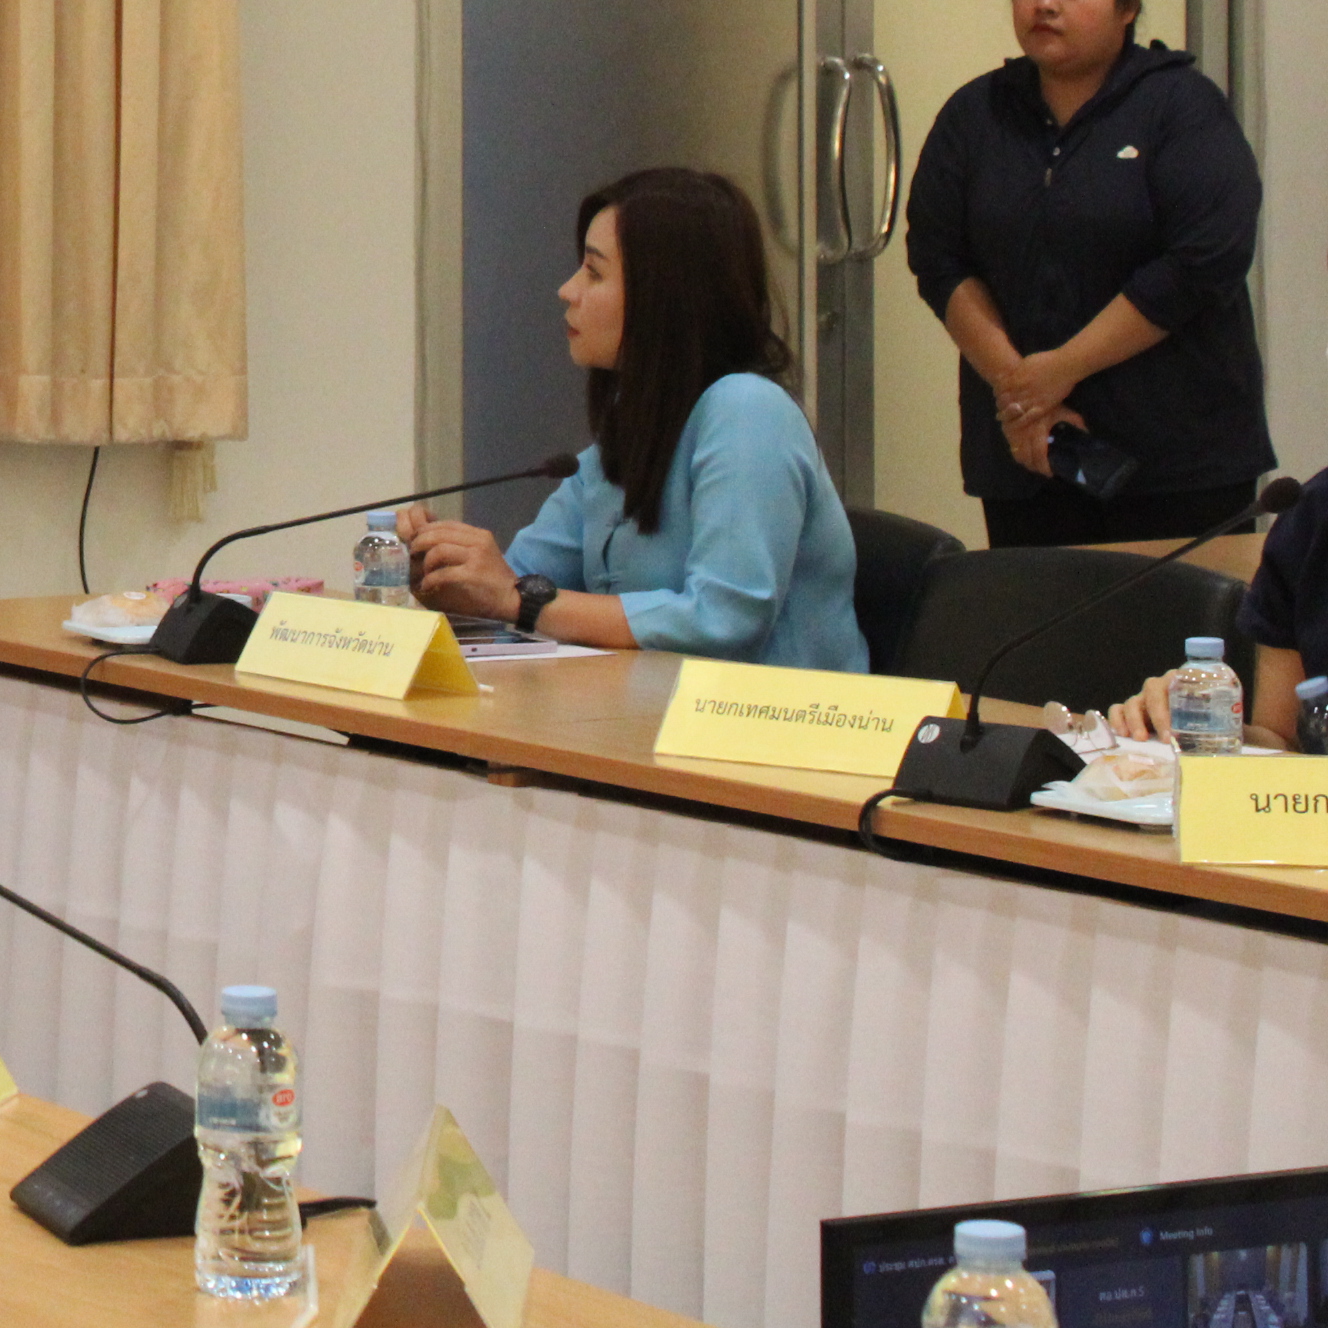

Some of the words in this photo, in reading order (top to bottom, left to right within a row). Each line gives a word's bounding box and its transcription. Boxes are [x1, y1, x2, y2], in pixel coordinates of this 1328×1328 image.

[269, 620, 394, 656] พัฒนาการจังหวัดน่าน
[694, 697, 894, 733] นายกเทศมนตรีเมืองน่าน
[1249, 792, 1328, 814] นายก
